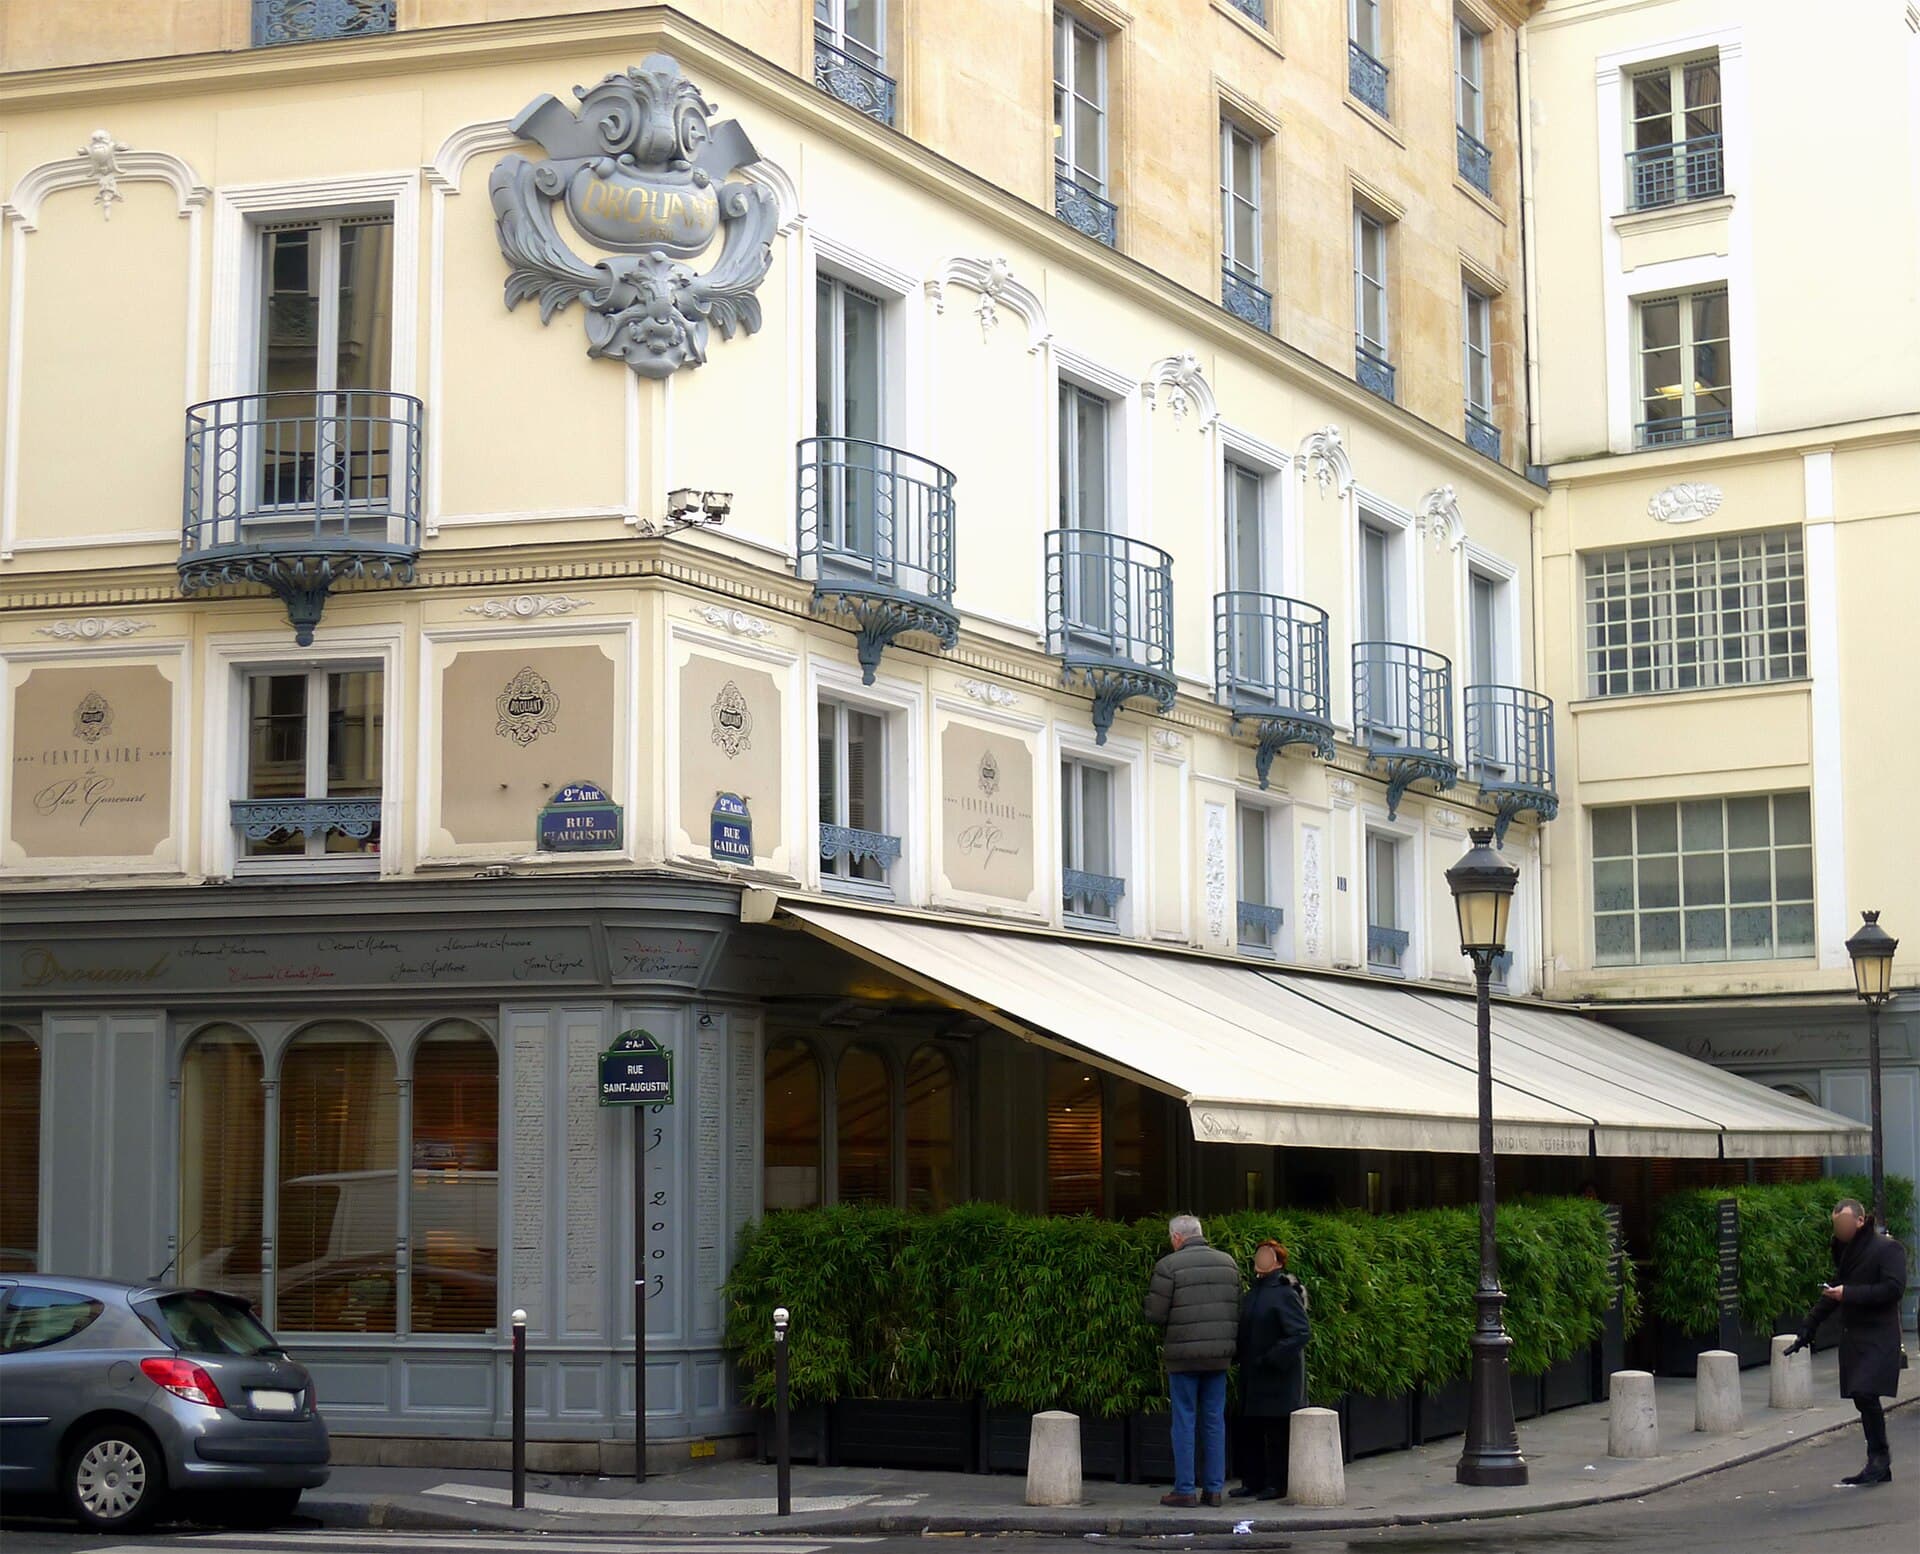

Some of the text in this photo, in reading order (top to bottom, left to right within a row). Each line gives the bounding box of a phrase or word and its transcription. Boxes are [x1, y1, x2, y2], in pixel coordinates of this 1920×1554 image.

[42, 747, 141, 765] CENTENAIRE
[566, 816, 595, 828] RUE
[557, 828, 617, 841] AUGUSTIN
[723, 826, 740, 840] RUE
[714, 839, 750, 856] GAILLON
[18, 944, 170, 987] Drouant
[627, 1064, 644, 1075] RUE
[603, 1081, 669, 1093] SAINT-AUGUSTIN
